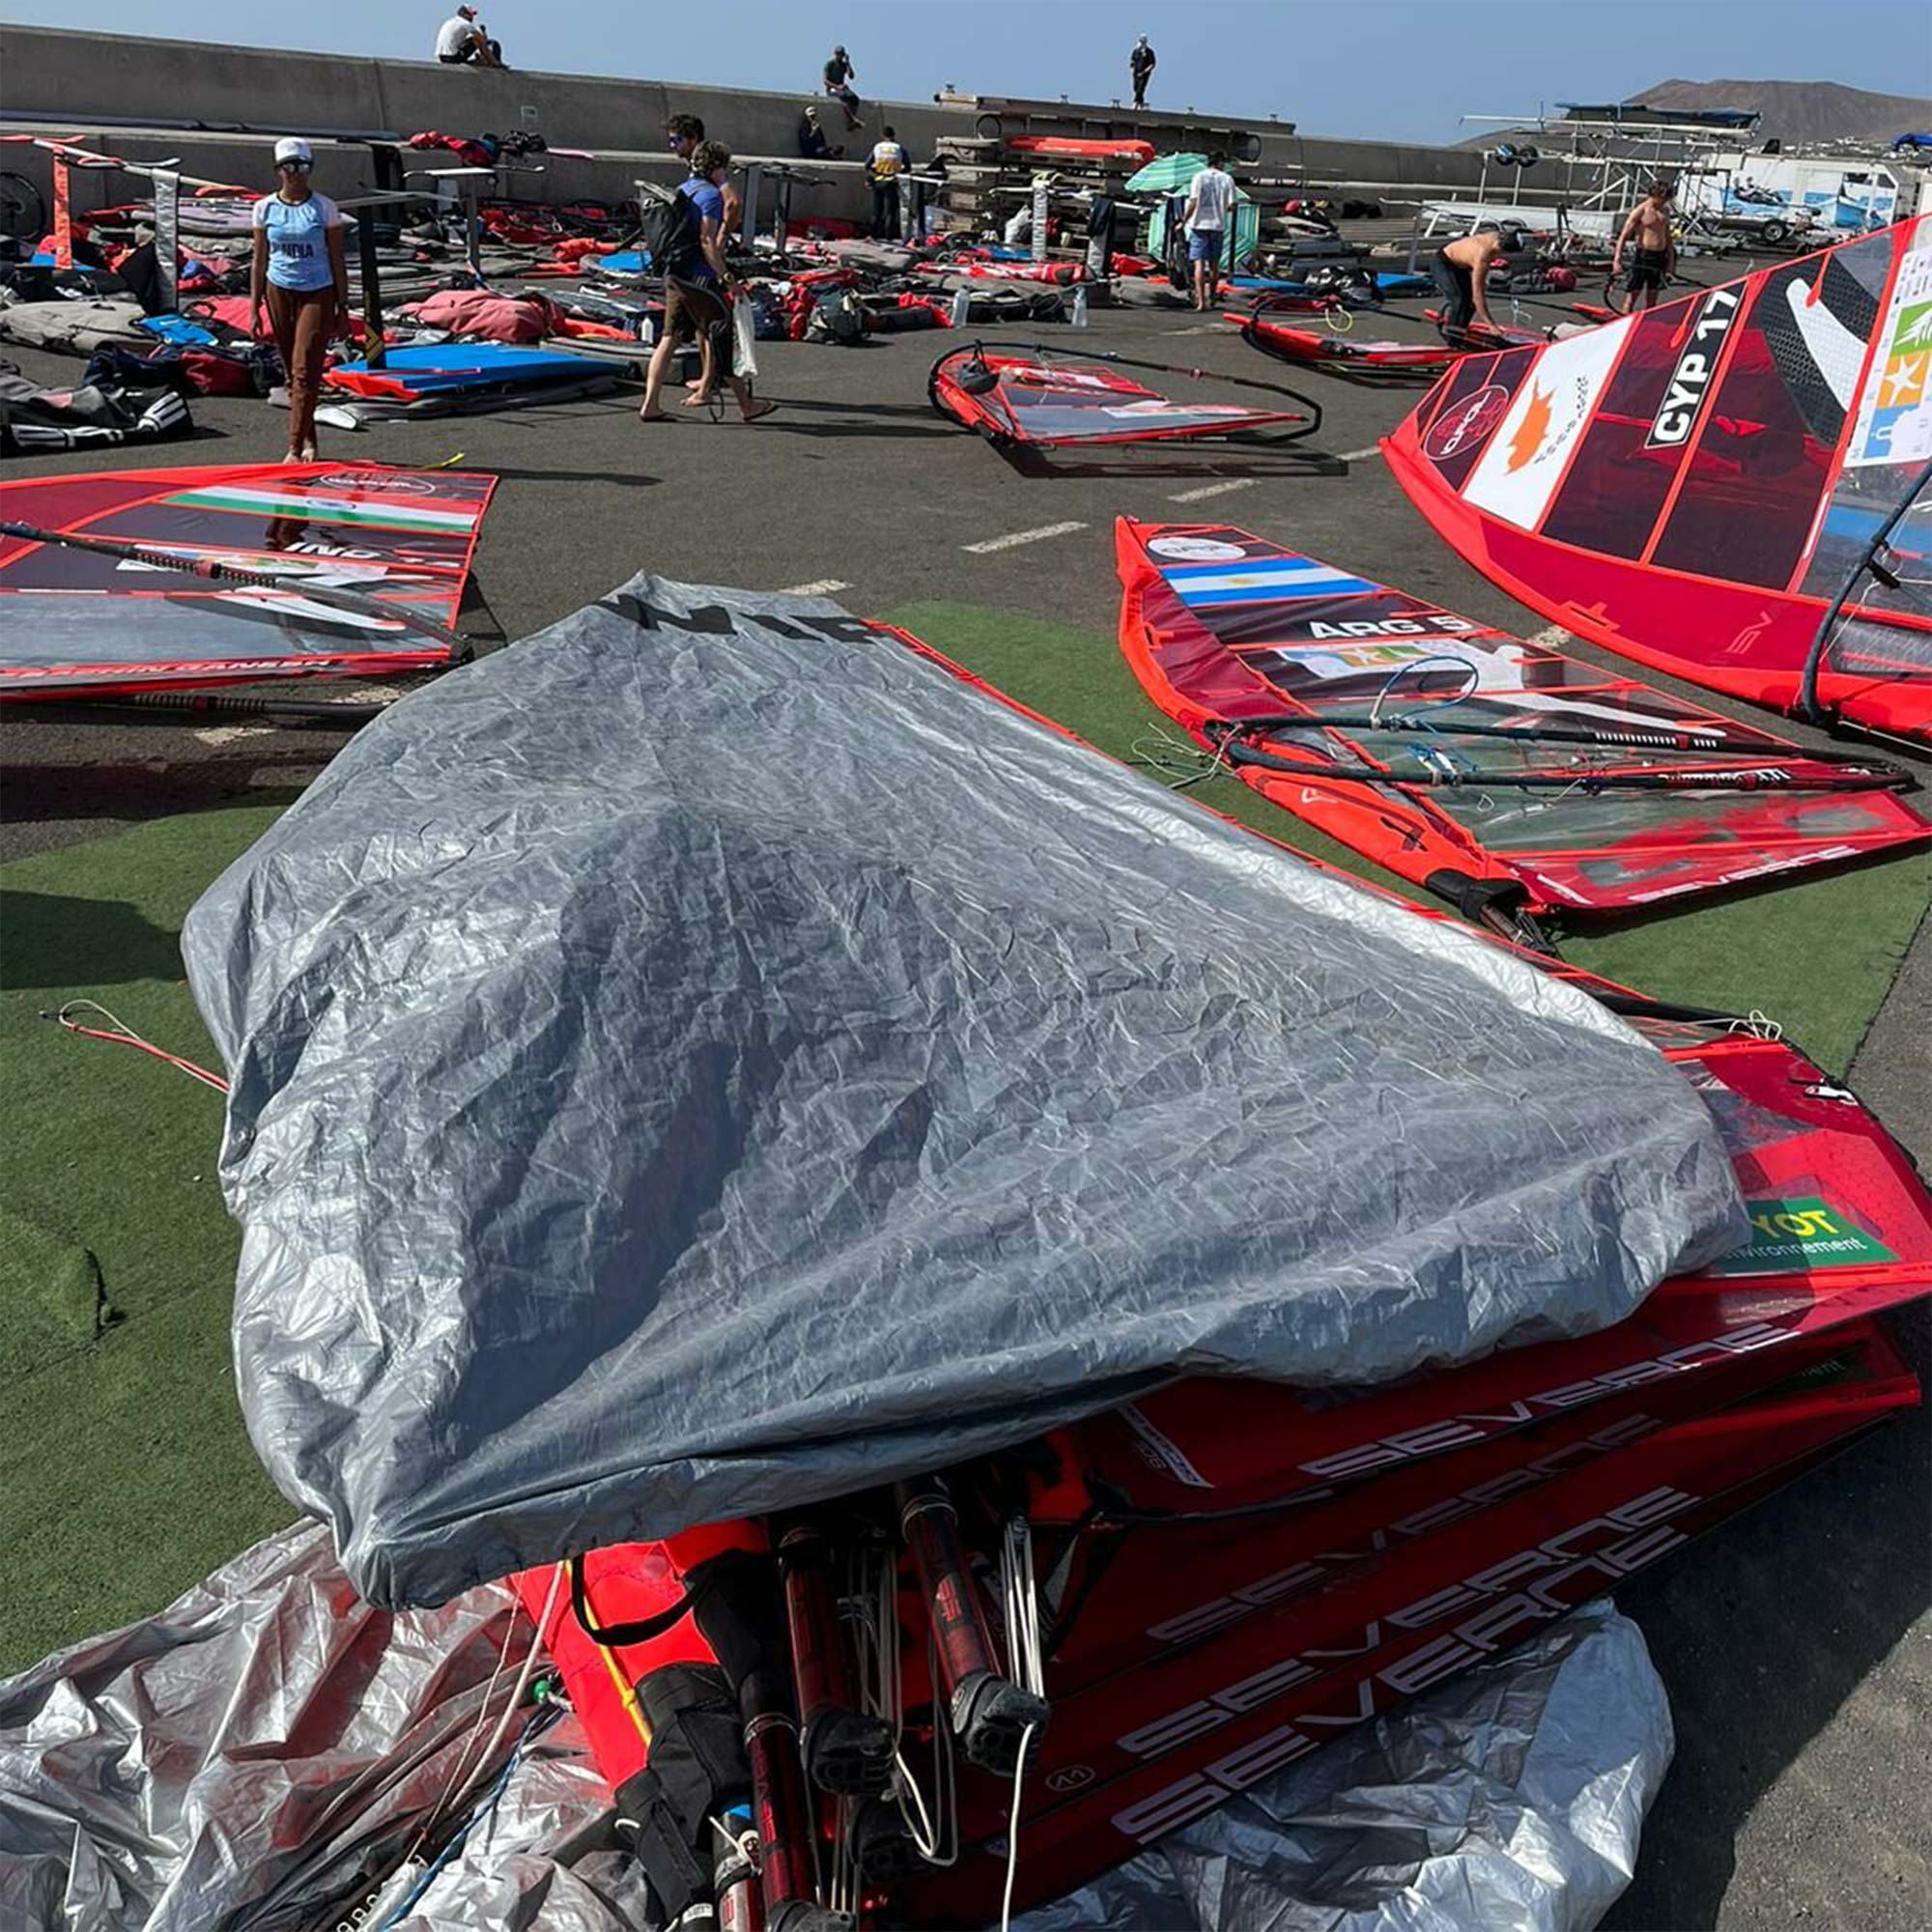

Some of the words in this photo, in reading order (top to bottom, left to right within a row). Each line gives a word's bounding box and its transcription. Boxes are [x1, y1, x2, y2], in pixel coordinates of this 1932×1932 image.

[1654, 354, 1709, 441] CYP
[1696, 291, 1739, 341] 17
[283, 541, 382, 559] IND
[1309, 619, 1426, 639] ARG
[1428, 615, 1475, 631] 5
[1297, 1322, 1803, 1479] SEVERNE
[1146, 1413, 1663, 1642] SEVERNE
[1110, 1525, 1690, 1844] SEVERNE
[1116, 1485, 1701, 1760] SEVERNE
